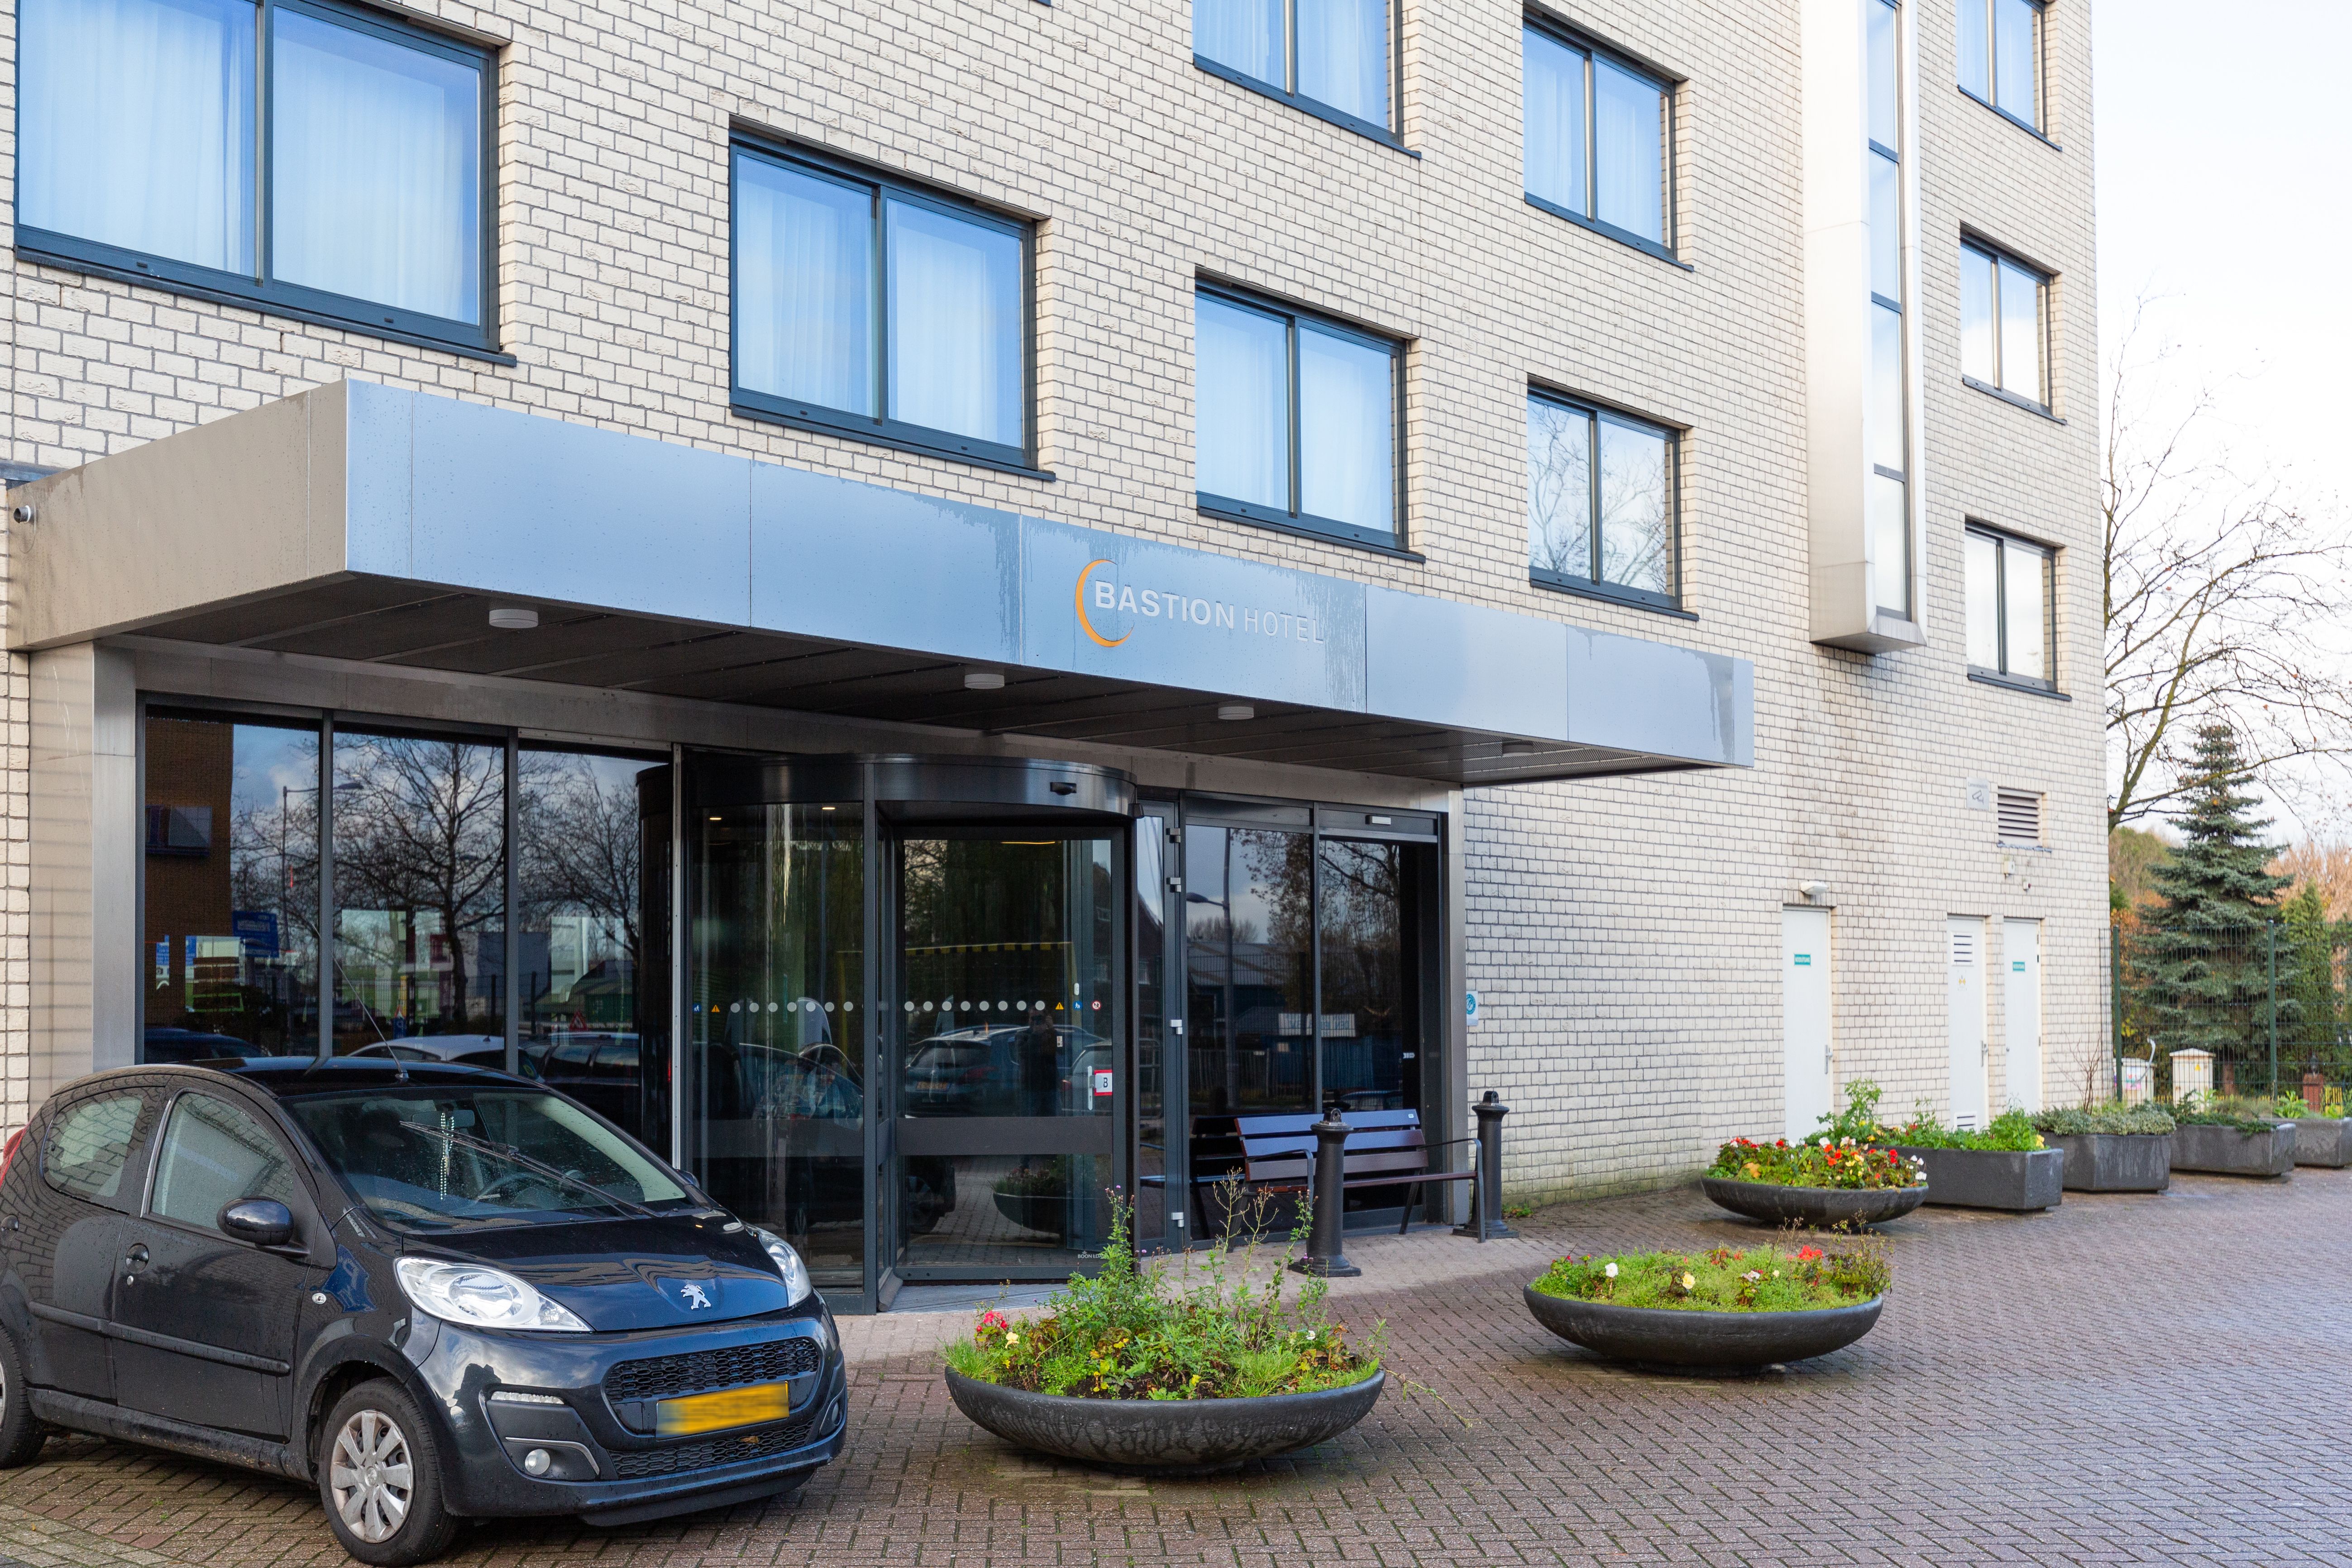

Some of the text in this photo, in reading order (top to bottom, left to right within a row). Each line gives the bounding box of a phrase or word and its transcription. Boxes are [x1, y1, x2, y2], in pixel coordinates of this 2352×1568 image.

[1095, 580, 1324, 644] BASTION HOTEL
[1104, 1077, 1108, 1088] B
